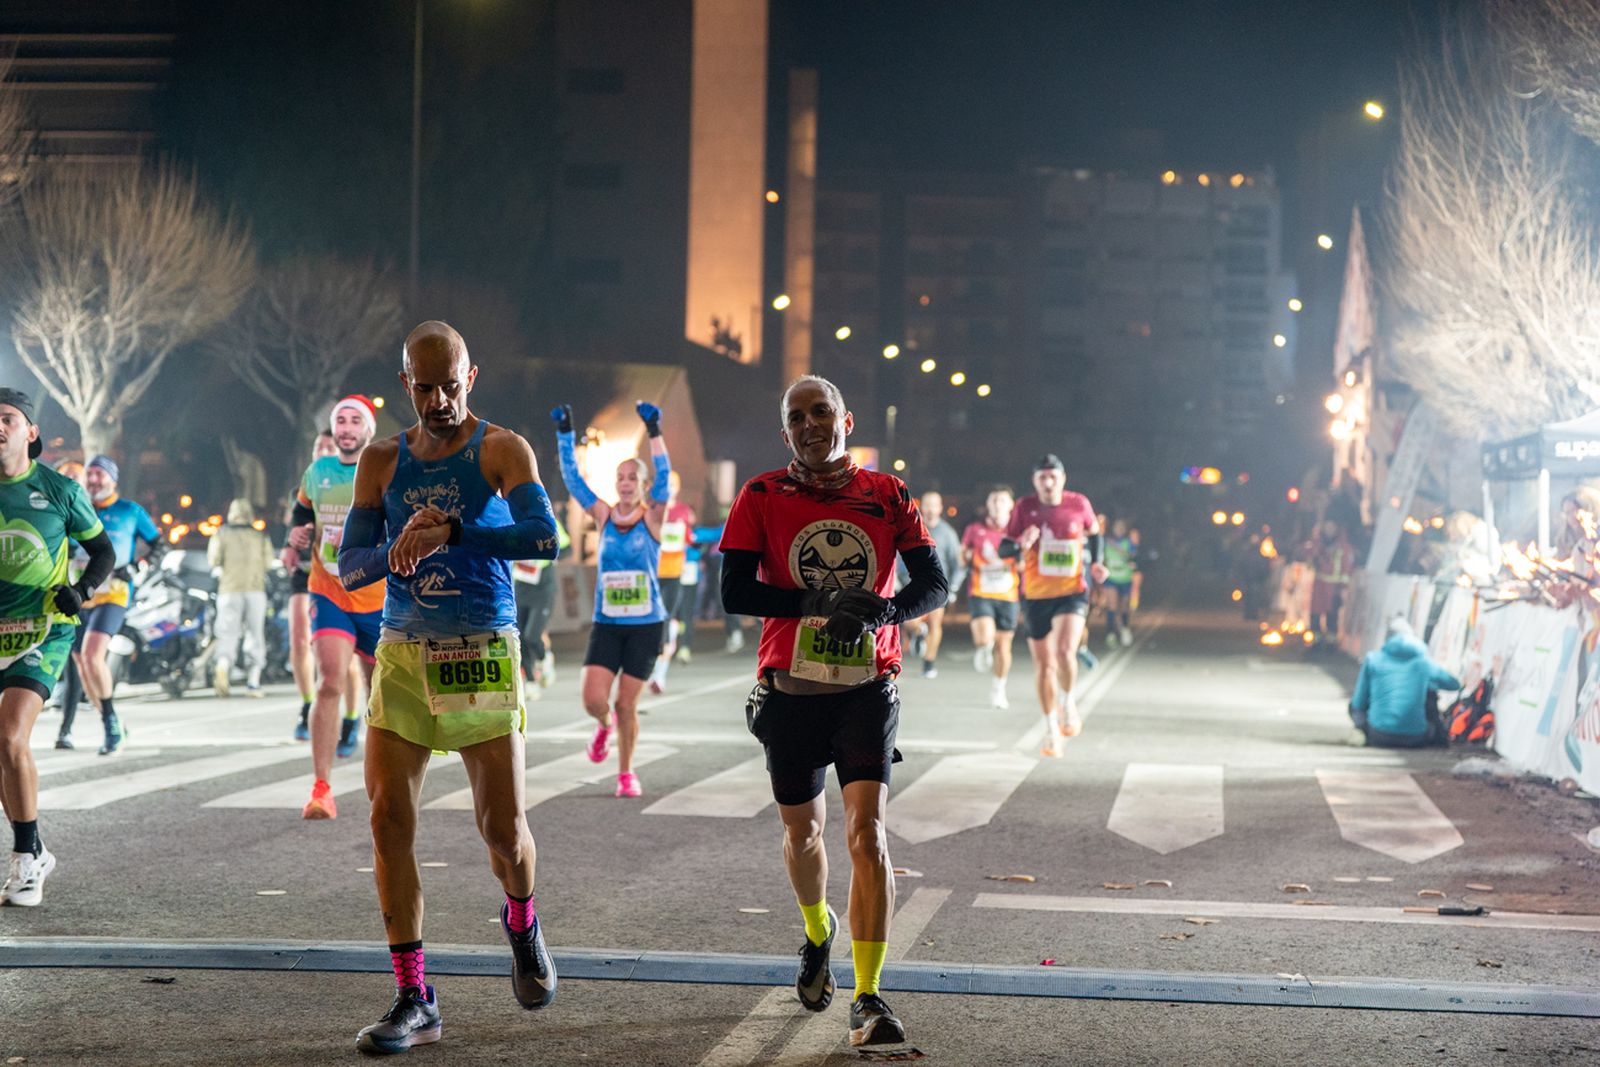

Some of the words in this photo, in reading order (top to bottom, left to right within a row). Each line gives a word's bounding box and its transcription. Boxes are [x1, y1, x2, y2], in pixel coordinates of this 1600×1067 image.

[794, 530, 811, 549] LOS
[431, 652, 450, 662] SAN
[439, 660, 501, 686] 8699
